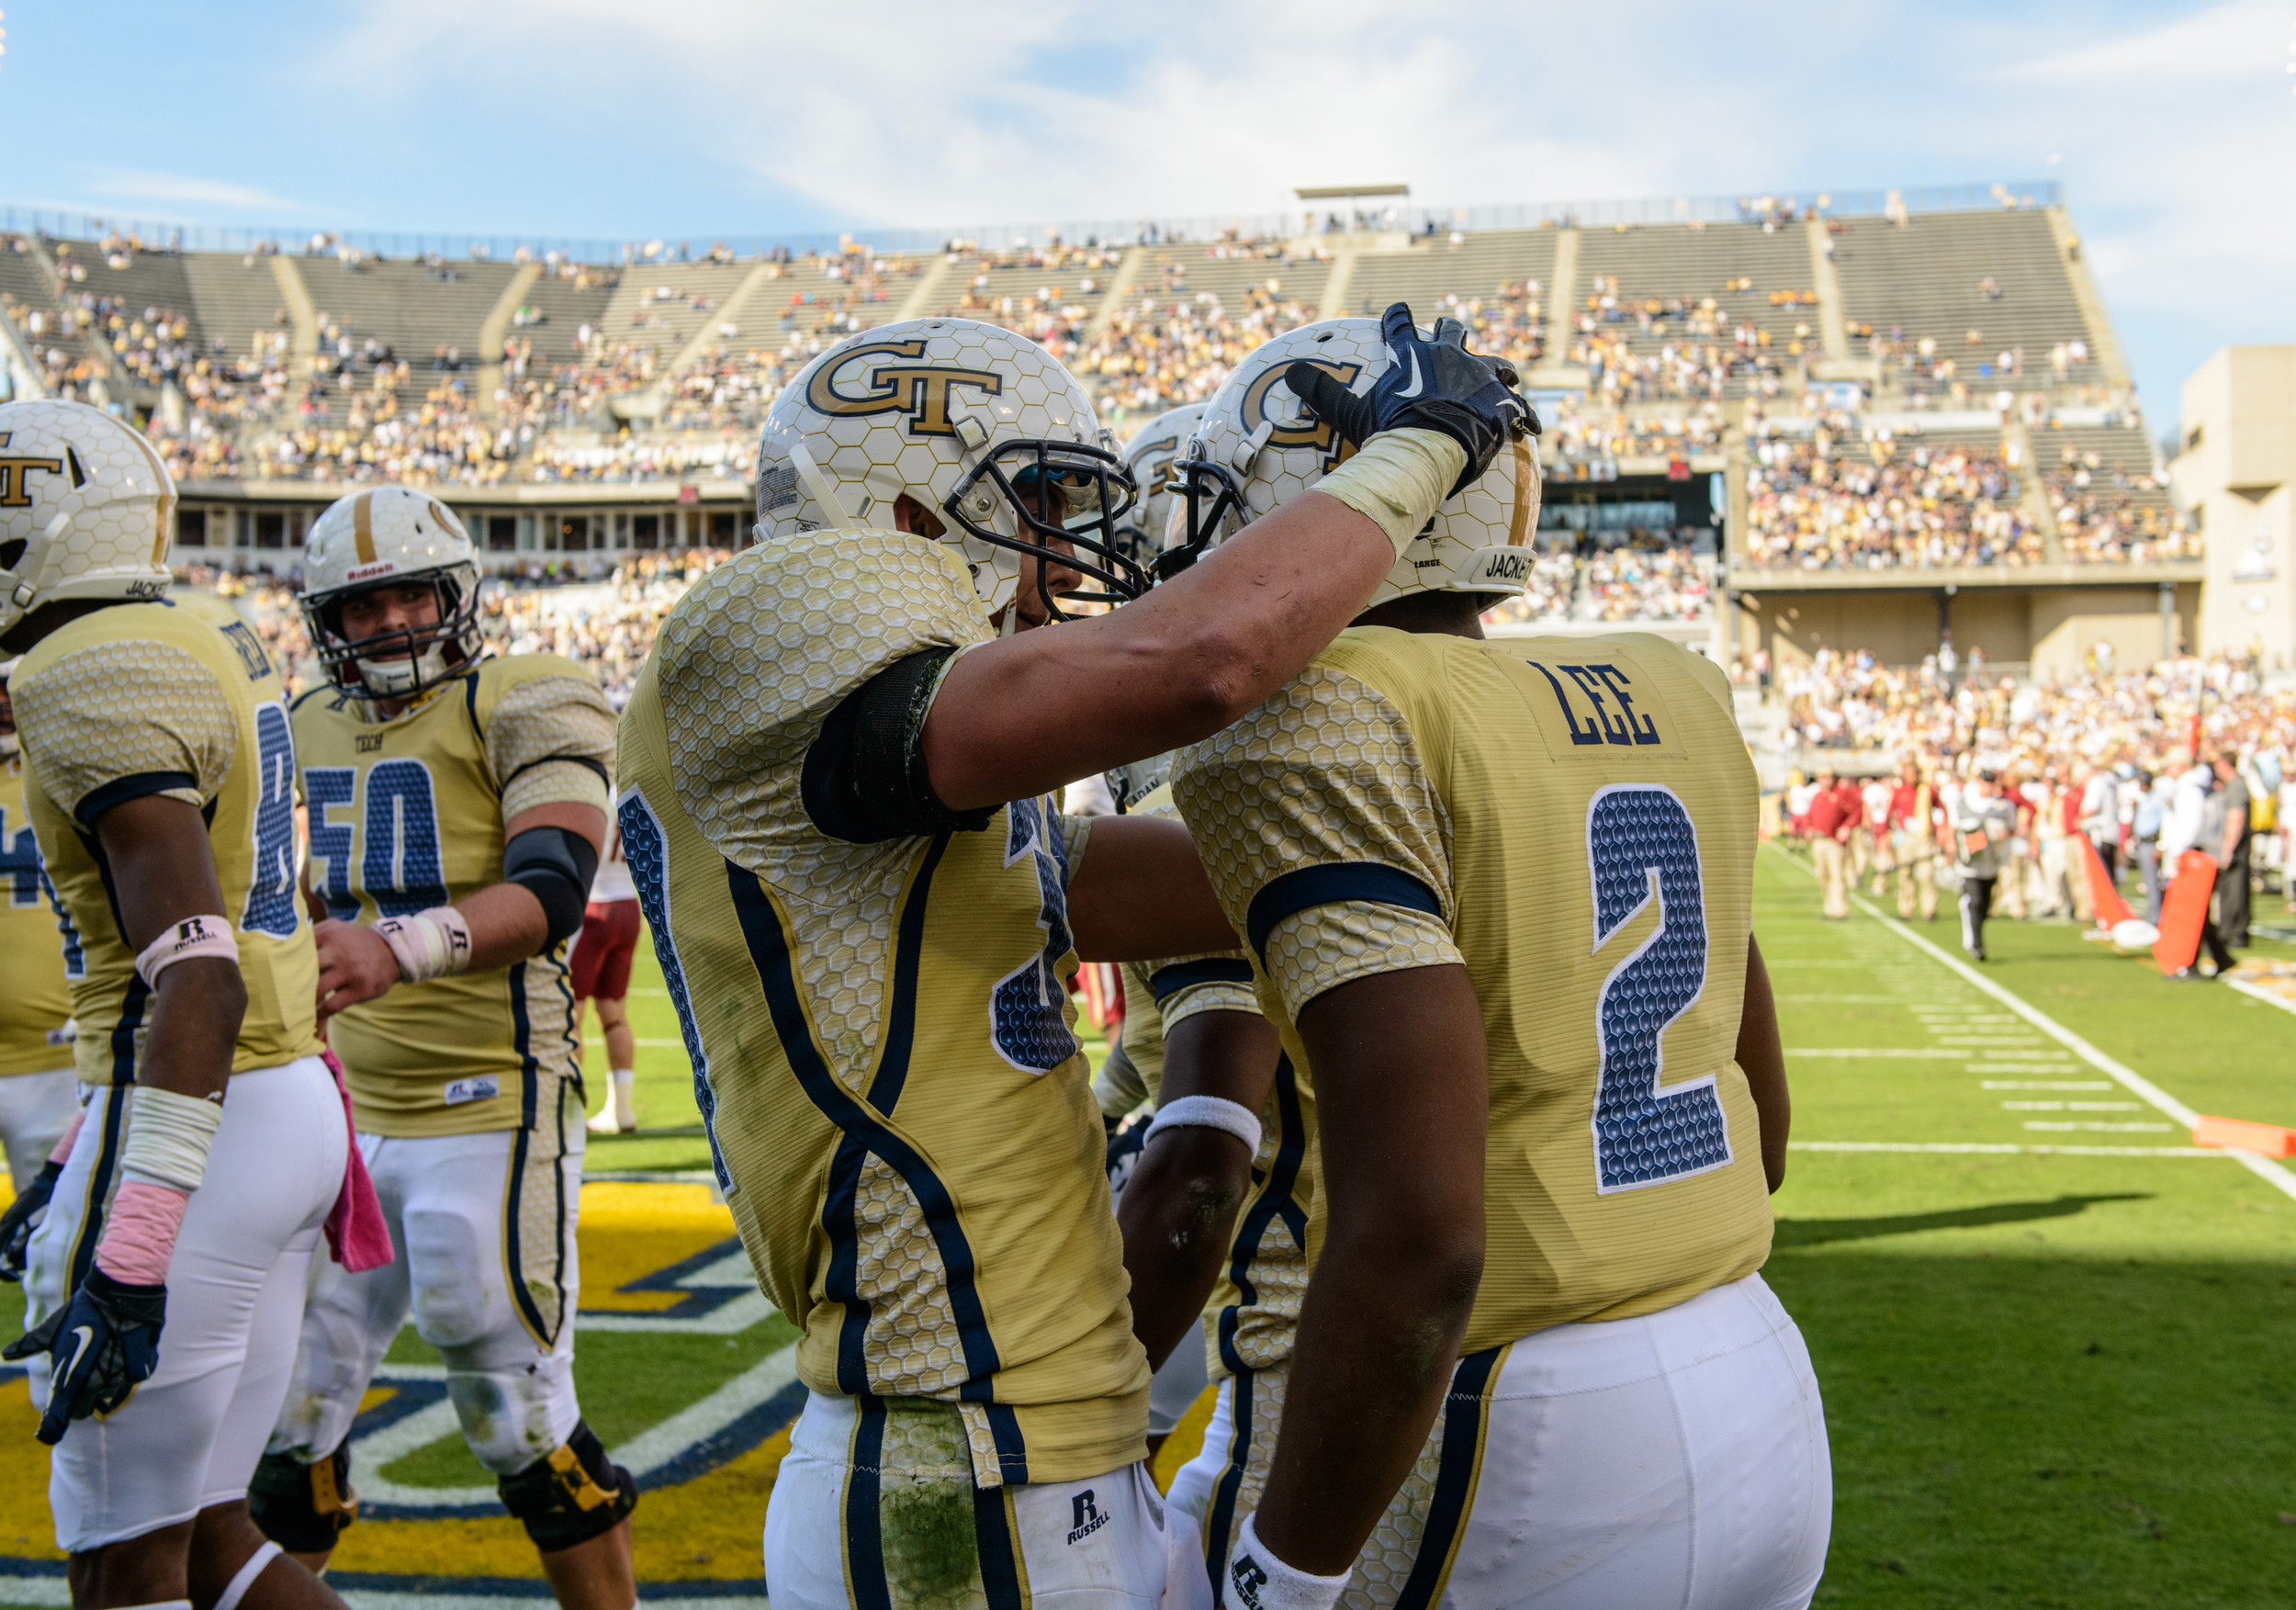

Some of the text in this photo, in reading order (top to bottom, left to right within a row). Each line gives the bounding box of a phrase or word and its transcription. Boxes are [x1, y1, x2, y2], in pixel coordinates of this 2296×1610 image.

[806, 340, 1002, 438] GT
[1240, 358, 1363, 475] G
[0, 432, 62, 507] T
[1414, 559, 1440, 569] LARGE
[1526, 659, 1661, 746] LEE
[355, 733, 383, 753] TECH
[302, 757, 449, 924] 50
[1585, 783, 1734, 1194] 2
[1067, 1511, 1110, 1546] RUSSELL
[1072, 1489, 1097, 1530] R
[1234, 1553, 1267, 1596] R
